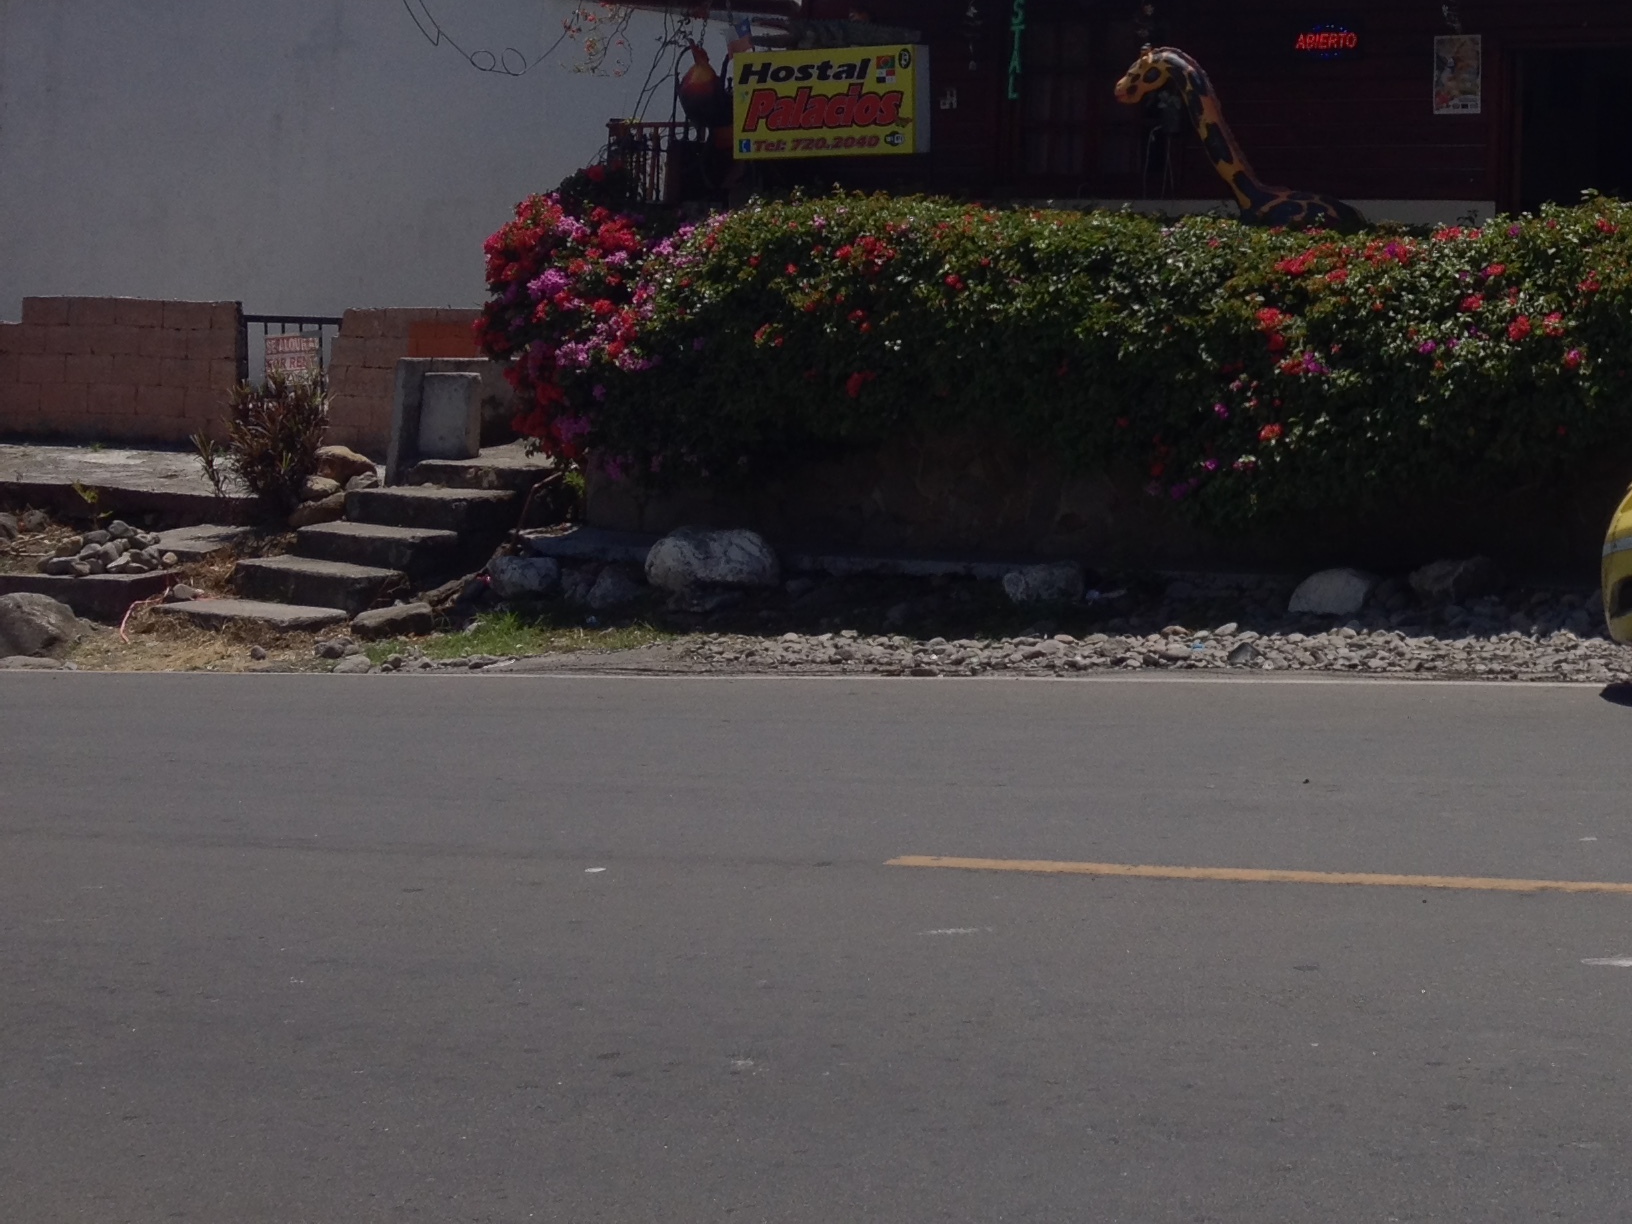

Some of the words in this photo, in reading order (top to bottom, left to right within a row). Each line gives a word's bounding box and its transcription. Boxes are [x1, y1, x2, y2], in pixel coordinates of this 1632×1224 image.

[1295, 32, 1358, 50] ABIERTO
[738, 57, 870, 84] Hostal
[741, 82, 905, 133] Palacios
[753, 138, 787, 152] Tel:
